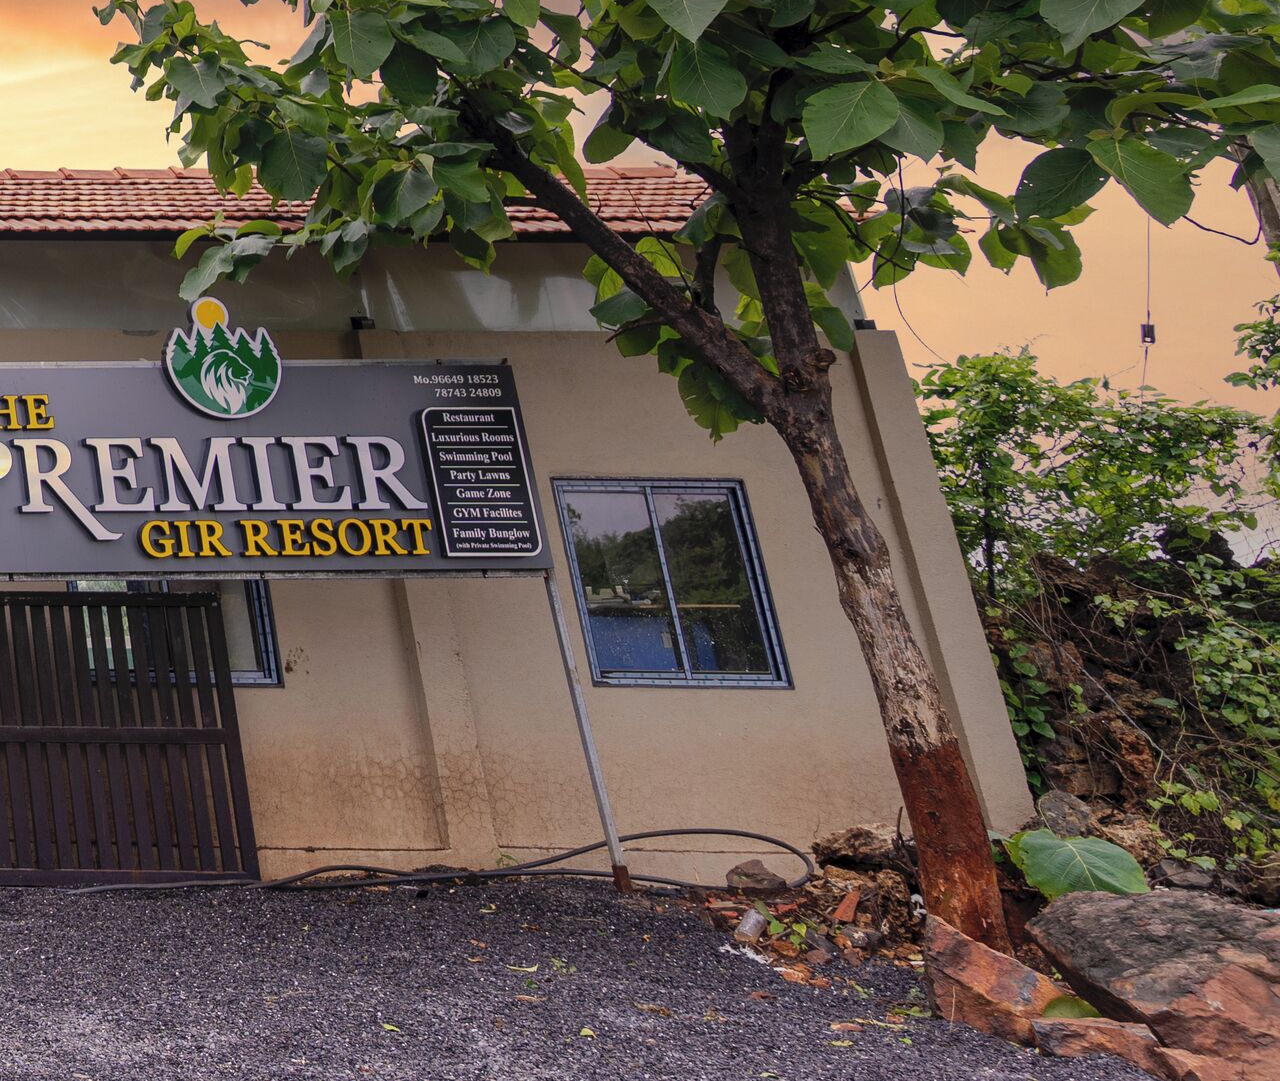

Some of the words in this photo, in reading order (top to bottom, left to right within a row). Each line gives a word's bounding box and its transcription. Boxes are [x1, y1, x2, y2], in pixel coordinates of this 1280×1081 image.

[413, 374, 464, 384] Mo.96649
[467, 374, 499, 384] 18523
[434, 388, 467, 397] 78743
[469, 388, 502, 397] 24809
[442, 412, 495, 422] Restaurant
[431, 432, 480, 442] Luxurious
[481, 432, 514, 442] Rooms
[439, 451, 490, 463] Swimming
[491, 451, 513, 461] Pool
[450, 470, 476, 482] Party
[478, 470, 511, 480] Lawns
[456, 488, 485, 498] Game
[486, 488, 512, 498] Zone
[453, 507, 481, 518] GYM
[482, 507, 523, 518] Facilites
[140, 520, 233, 558] GIR
[240, 518, 432, 557] RESORT
[452, 528, 486, 540] Family
[488, 528, 530, 540] Bunglow
